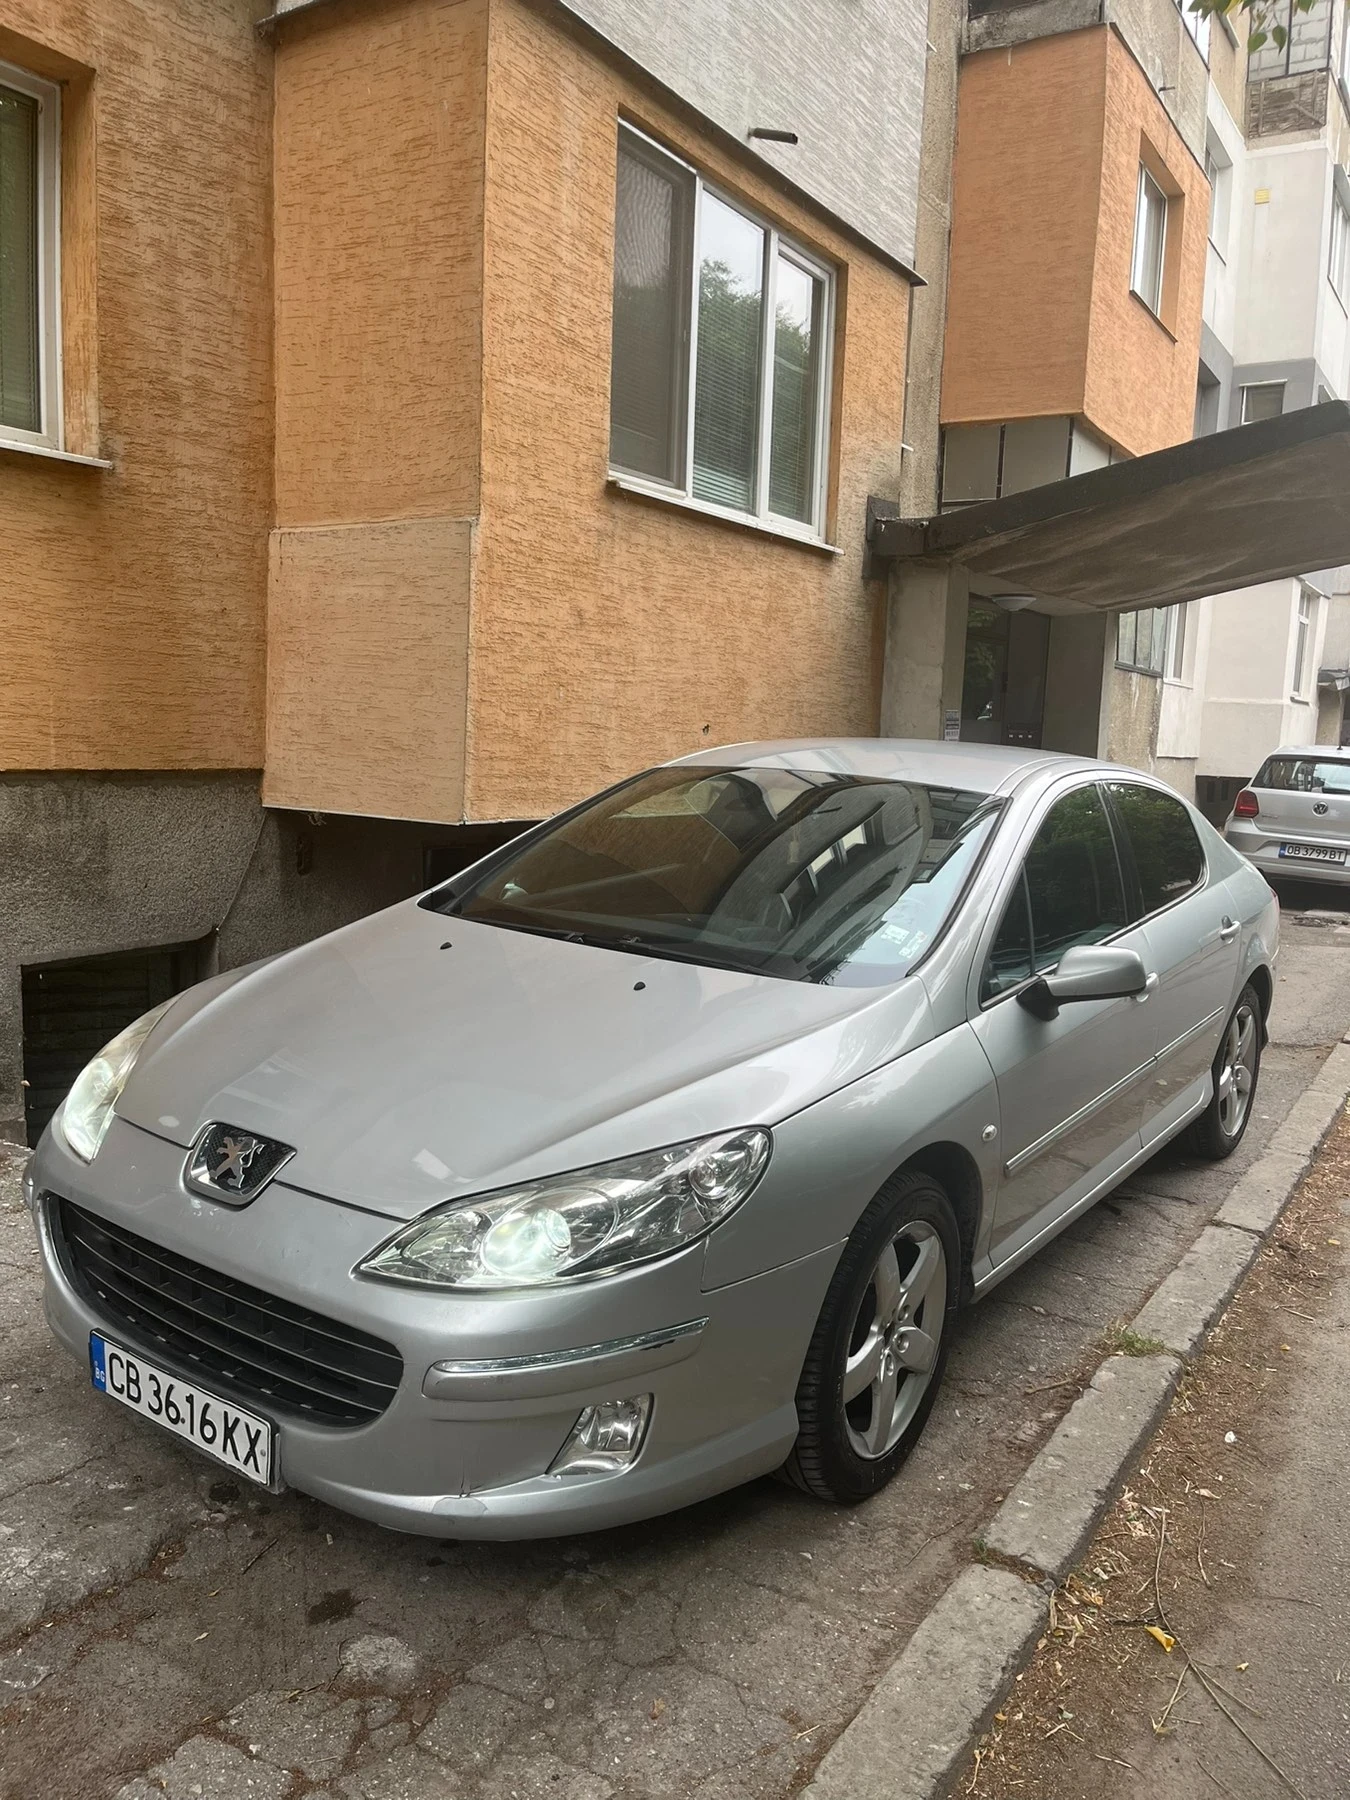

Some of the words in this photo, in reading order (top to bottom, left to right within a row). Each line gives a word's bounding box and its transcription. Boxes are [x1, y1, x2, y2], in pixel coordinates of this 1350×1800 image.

[1302, 847, 1328, 858] 3799
[1329, 850, 1344, 860] BT
[95, 1366, 106, 1383] BG
[108, 1352, 142, 1405] CB
[147, 1374, 217, 1445] 3616
[222, 1410, 262, 1475] KX
